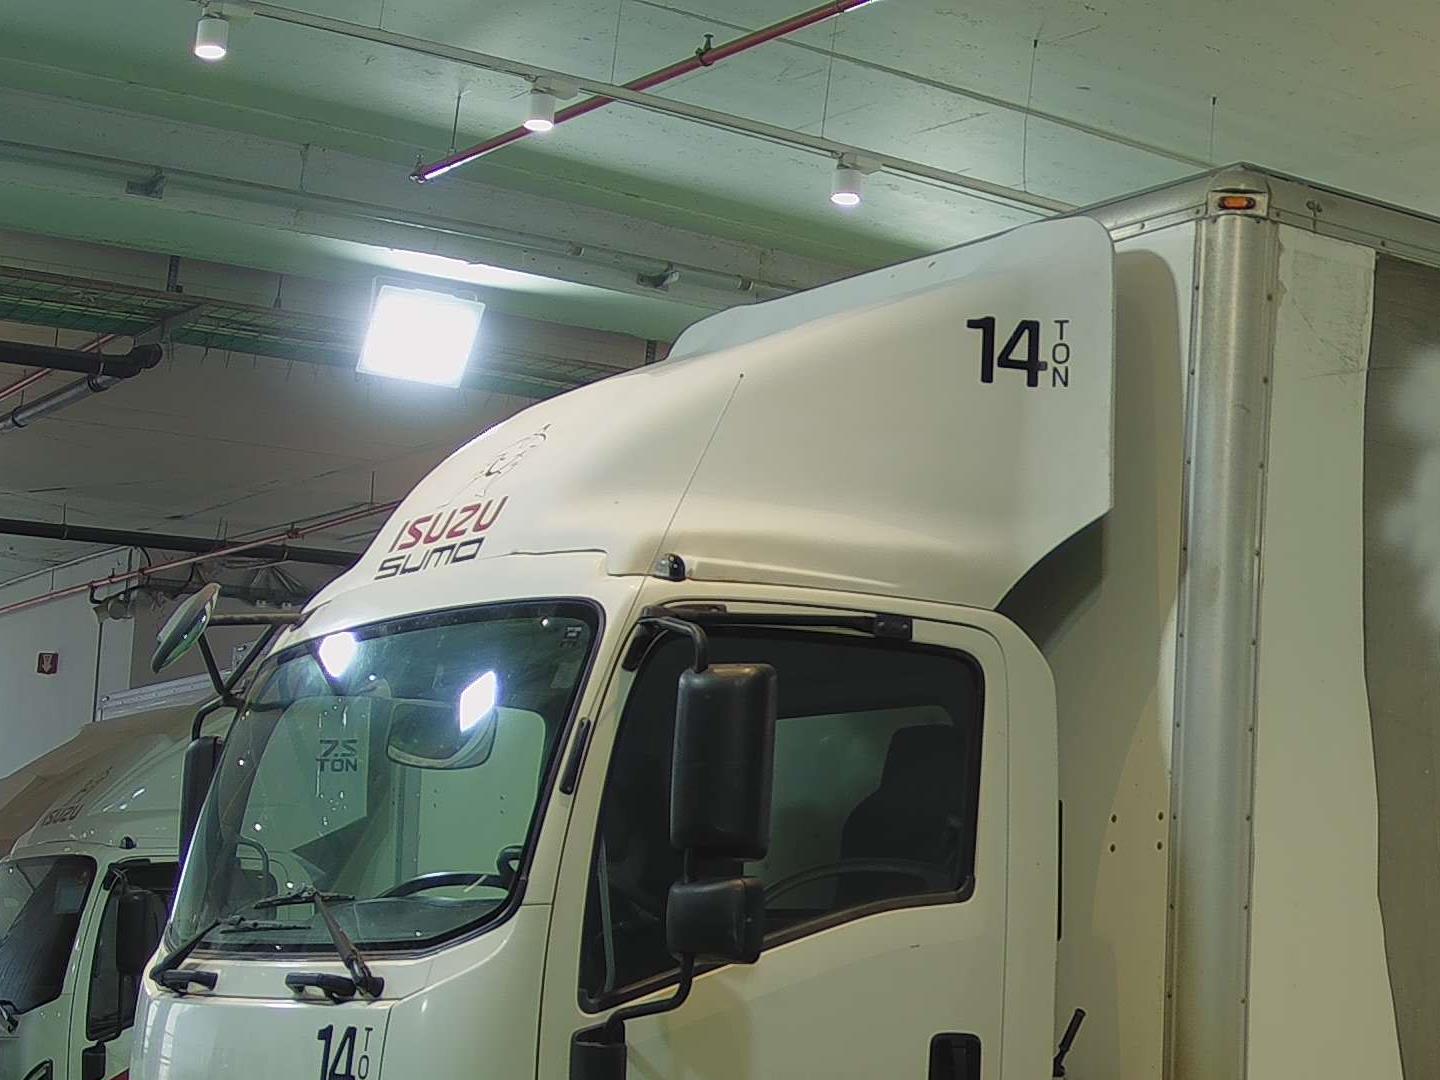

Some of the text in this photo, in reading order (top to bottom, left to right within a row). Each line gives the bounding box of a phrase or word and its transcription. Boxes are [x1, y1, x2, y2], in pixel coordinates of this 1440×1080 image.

[966, 315, 1070, 388] 14 TON
[387, 495, 509, 554] ISUZU
[373, 536, 486, 581] SUMO
[315, 757, 358, 772] TON
[319, 738, 358, 758] 7.5
